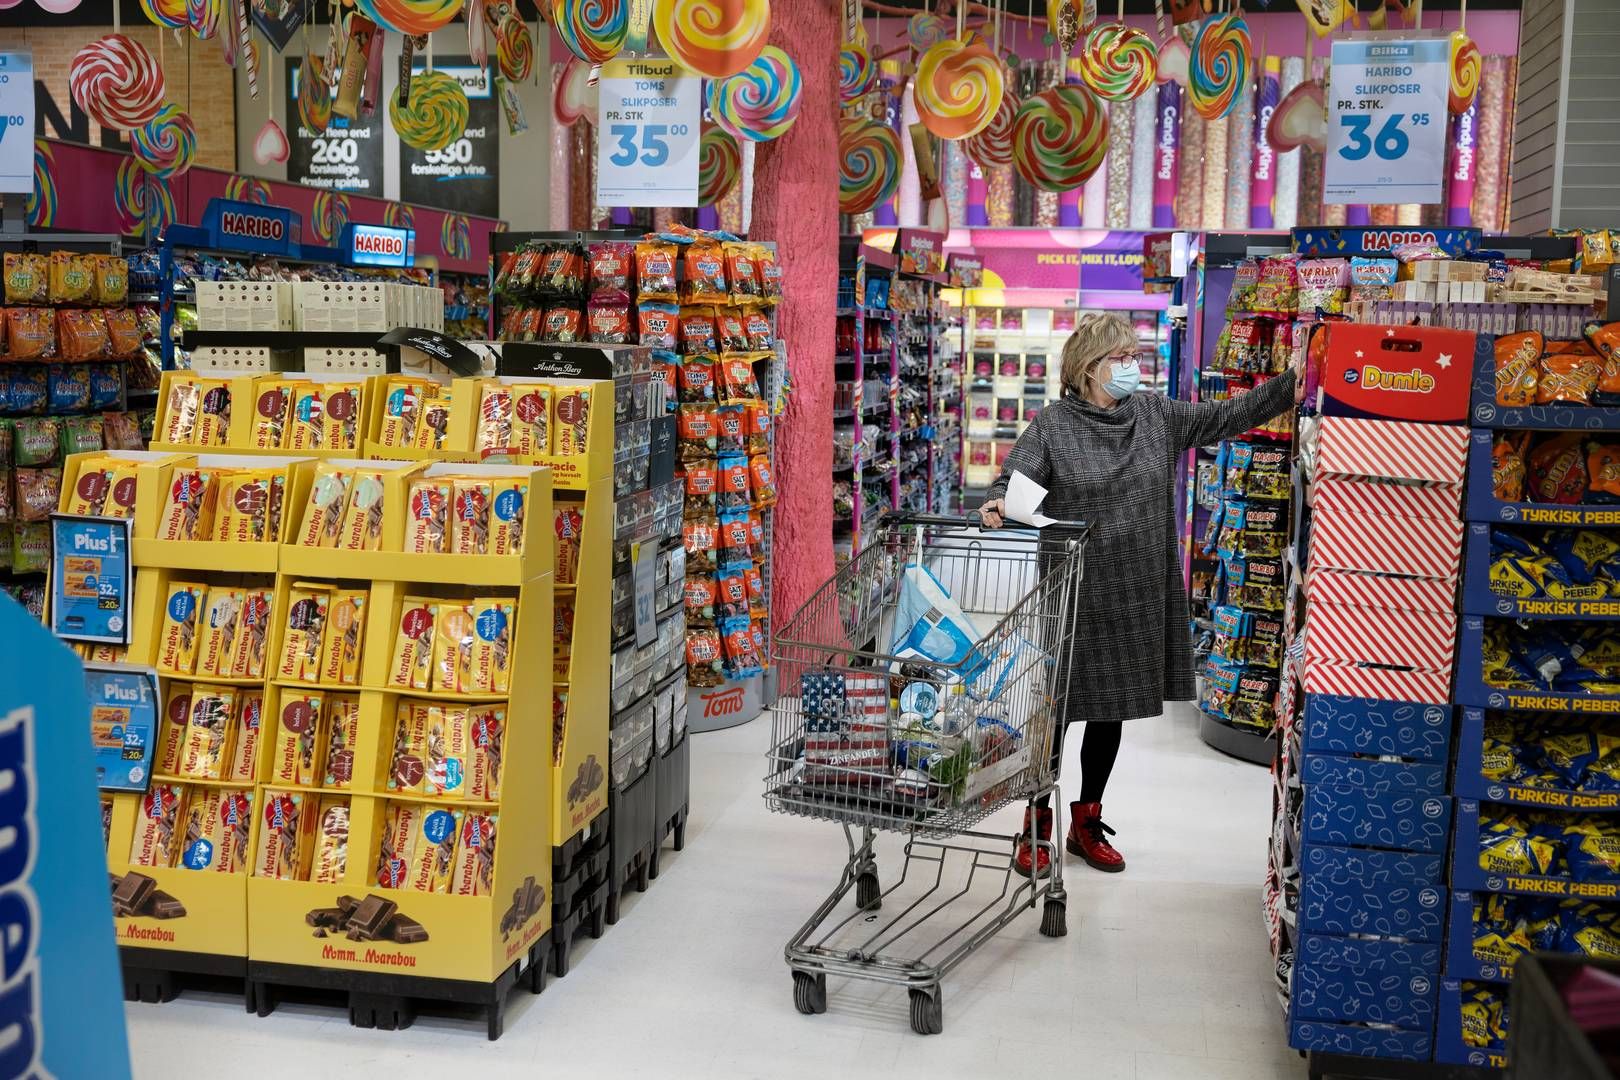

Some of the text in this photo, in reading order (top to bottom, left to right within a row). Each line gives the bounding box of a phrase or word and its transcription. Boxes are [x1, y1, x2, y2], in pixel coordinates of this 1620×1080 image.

[1371, 46, 1408, 56] Bilka
[626, 65, 673, 76] Tilbud
[1366, 66, 1412, 77] HARIBO
[635, 82, 665, 91] TOMS
[1355, 84, 1420, 95] SLIKPOSER
[622, 98, 677, 107] SLIKPOSER
[1338, 100, 1384, 110] PR. STK.
[606, 112, 622, 120] PR.
[609, 124, 688, 167] 35 00
[1338, 114, 1430, 160] 36 95
[311, 138, 359, 164] 260
[223, 212, 284, 240] HARIBO
[355, 233, 404, 254] HARIBO
[1037, 254, 1064, 264] PICK
[1080, 254, 1104, 264] MIX
[648, 320, 668, 328] SALT
[1361, 365, 1434, 393] Dumle
[1584, 514, 1620, 524] PEBE
[74, 534, 108, 551] Plus
[162, 625, 179, 667] Marabou
[204, 630, 220, 672] Marabou
[234, 631, 250, 673] Marabou
[326, 636, 342, 678] Marabou
[395, 643, 414, 684] Marabou
[104, 684, 138, 700] Plus
[700, 687, 744, 718] Toms
[162, 728, 180, 770] Marabou
[238, 734, 254, 776] Marabou
[280, 736, 296, 780] Marabou
[829, 748, 880, 766] ZINFANDEL
[1572, 793, 1618, 808] PEBER
[264, 834, 278, 877] Marabou
[415, 846, 435, 890] Marabou
[1568, 880, 1616, 896] PEBER
